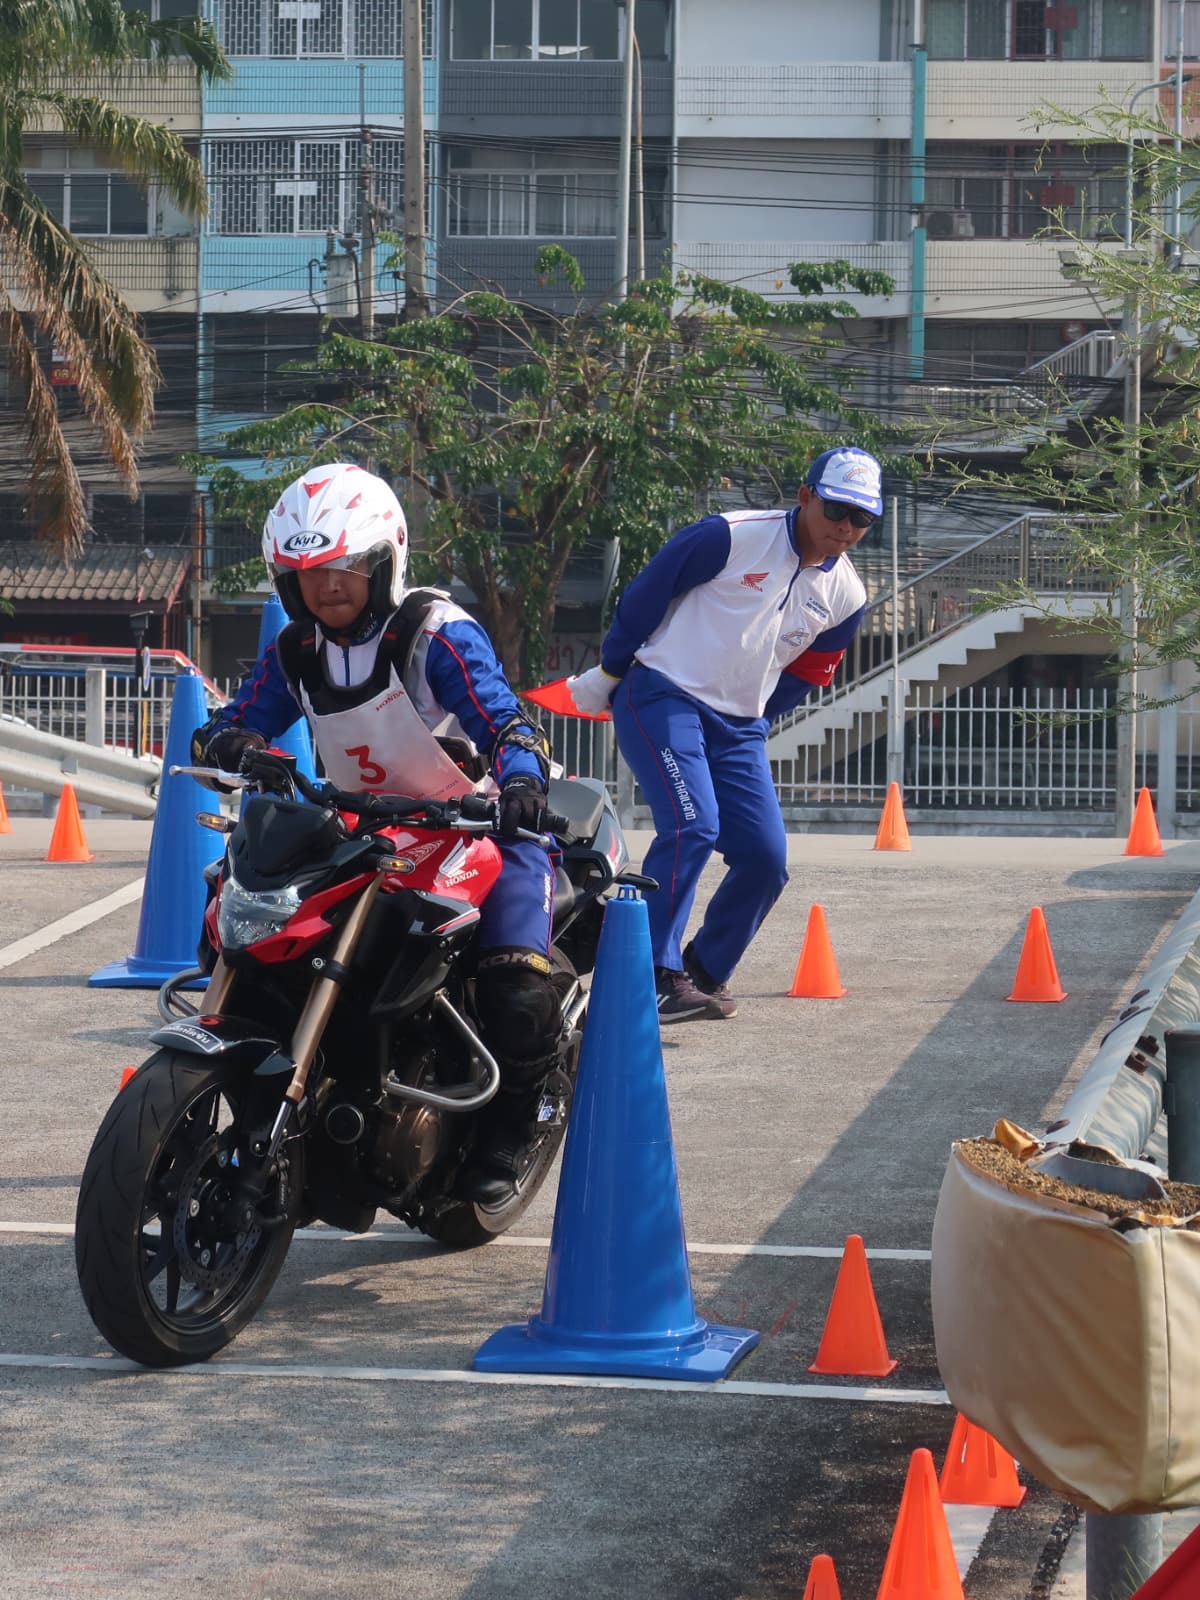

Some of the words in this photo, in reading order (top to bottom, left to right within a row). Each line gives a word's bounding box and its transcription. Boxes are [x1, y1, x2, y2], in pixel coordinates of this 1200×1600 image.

[375, 689, 405, 712] HONDA
[344, 744, 387, 785] 3
[661, 747, 696, 821] SAFETY-THAILAND
[445, 868, 479, 888] HONDA
